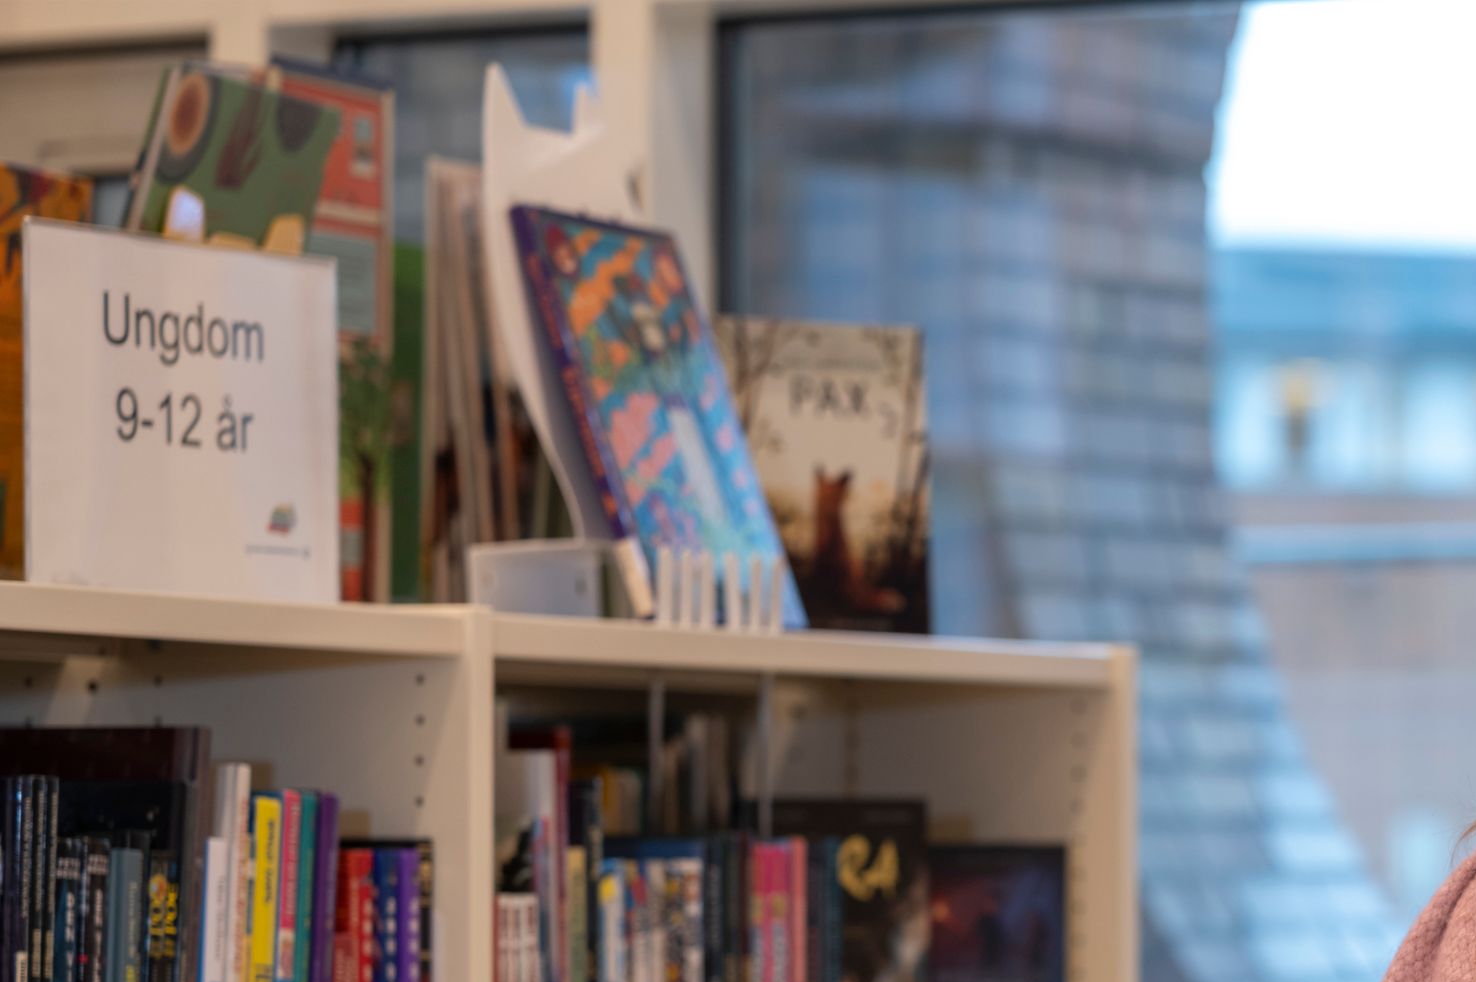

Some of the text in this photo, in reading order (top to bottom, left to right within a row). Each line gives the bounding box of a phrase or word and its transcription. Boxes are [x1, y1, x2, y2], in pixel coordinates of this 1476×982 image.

[102, 290, 265, 366] Ungdom
[115, 386, 254, 453] 9-12 år
